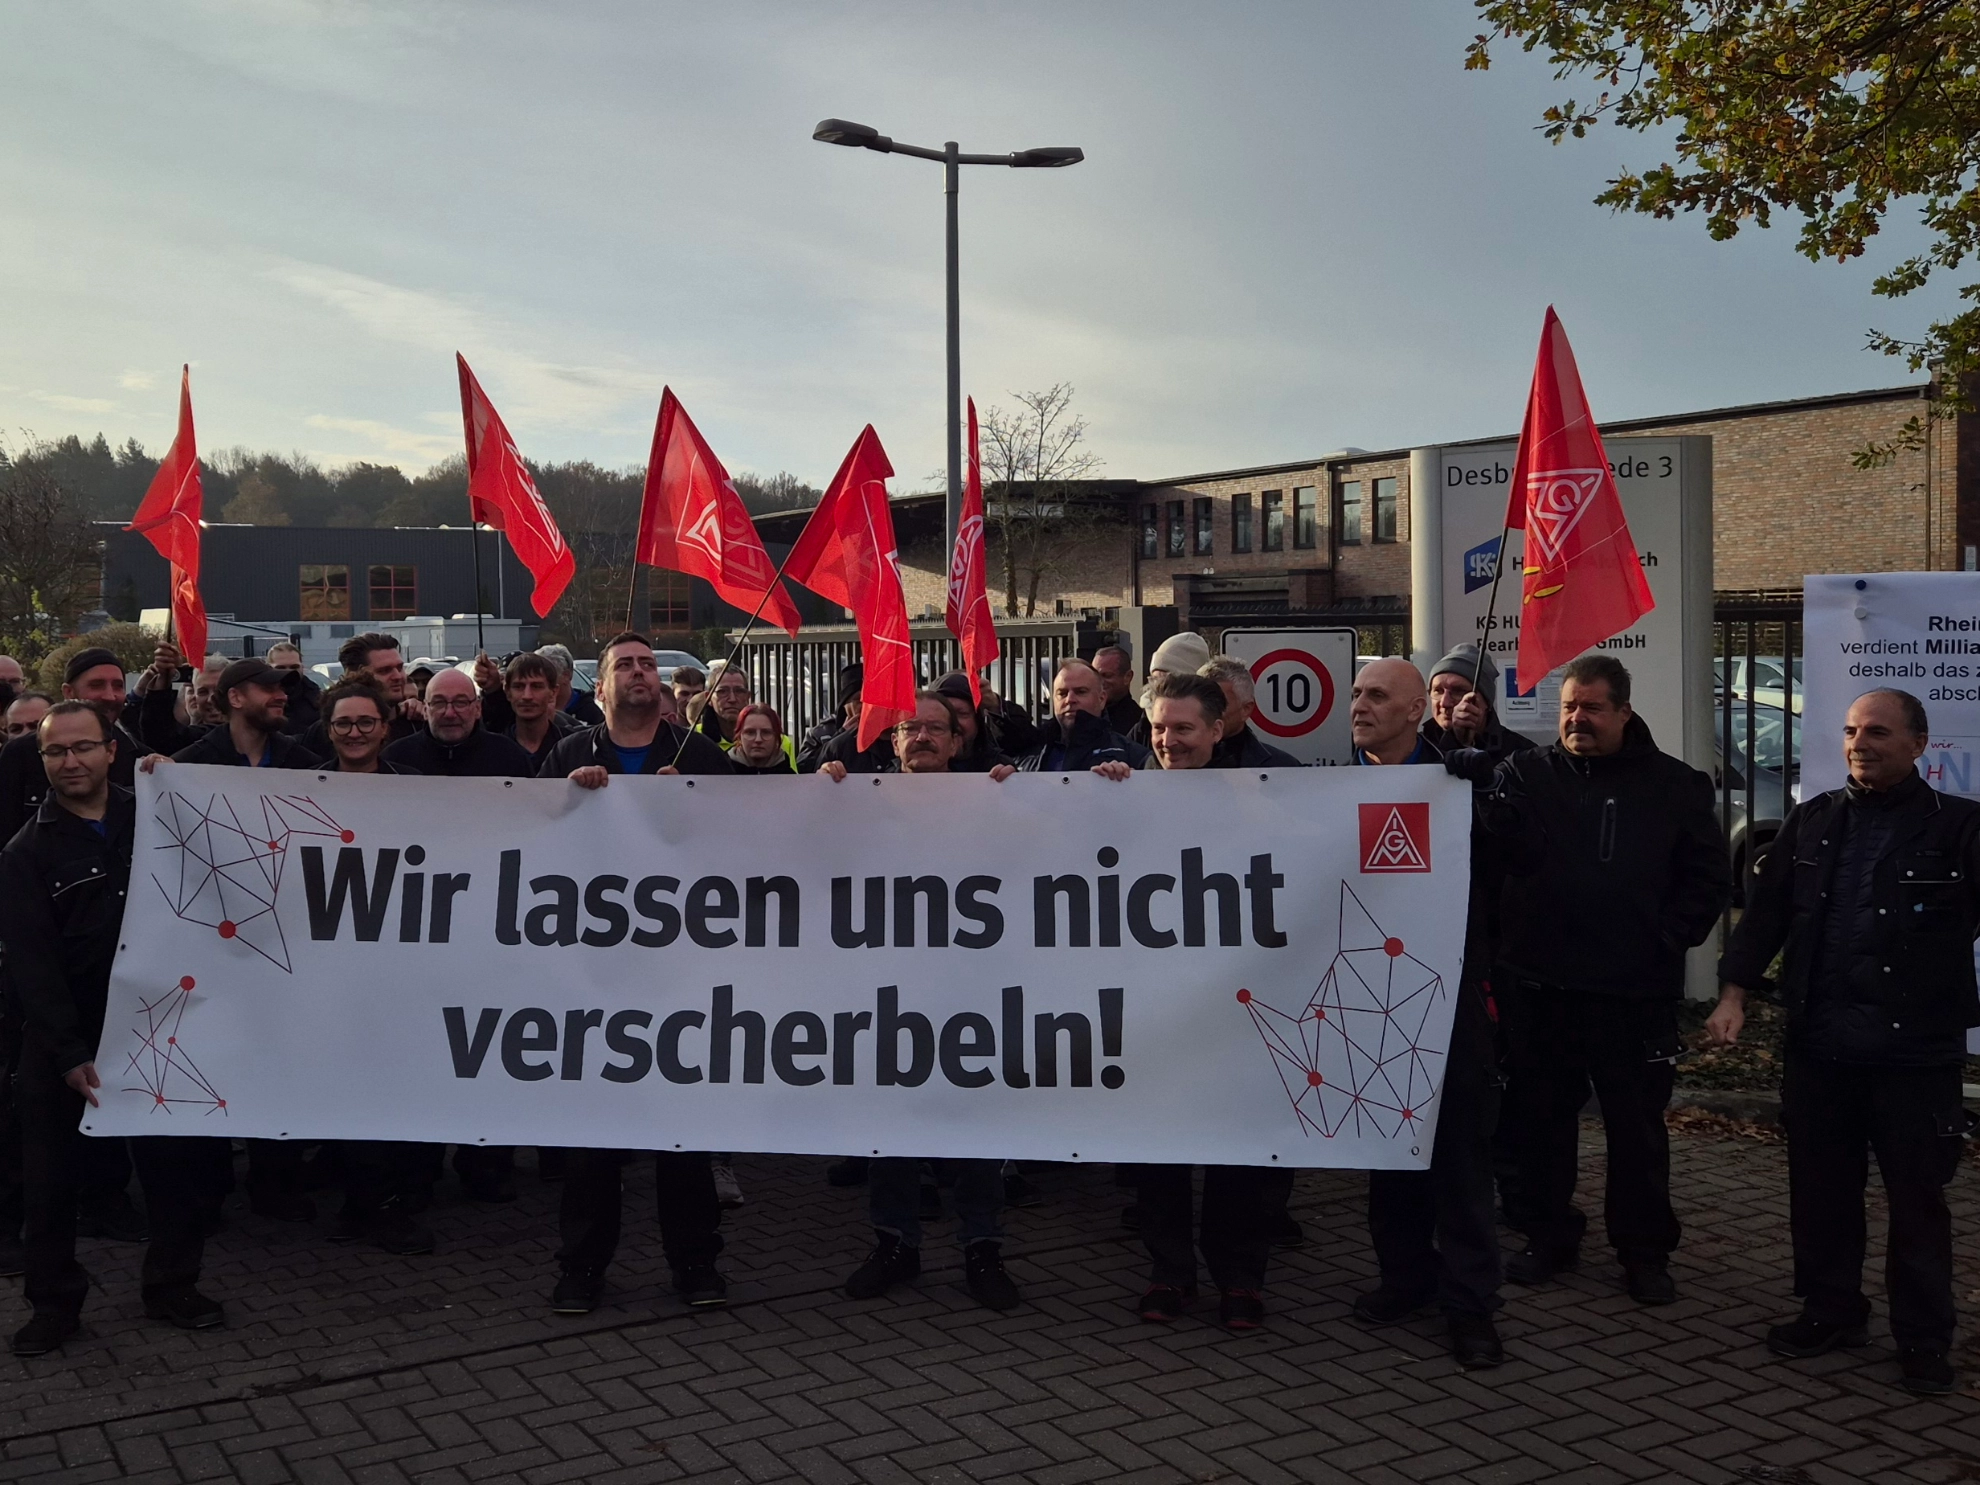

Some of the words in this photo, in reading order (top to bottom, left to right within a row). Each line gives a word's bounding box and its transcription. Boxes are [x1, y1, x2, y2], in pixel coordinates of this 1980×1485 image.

[1447, 462, 1514, 487] Desb
[1658, 456, 1672, 478] 3
[1928, 616, 1980, 631] Rhei
[1841, 639, 1918, 654] verdient
[1926, 639, 1980, 654] Millia
[1849, 662, 1926, 677] deshalb
[1933, 662, 1969, 677] das
[1266, 673, 1310, 713] 10
[1929, 685, 1980, 701] absc
[300, 845, 471, 943] Wir
[495, 849, 799, 948] lassen
[831, 875, 1004, 949] uns
[1034, 846, 1288, 948] nicht
[442, 985, 1125, 1089] verscherbeln!
